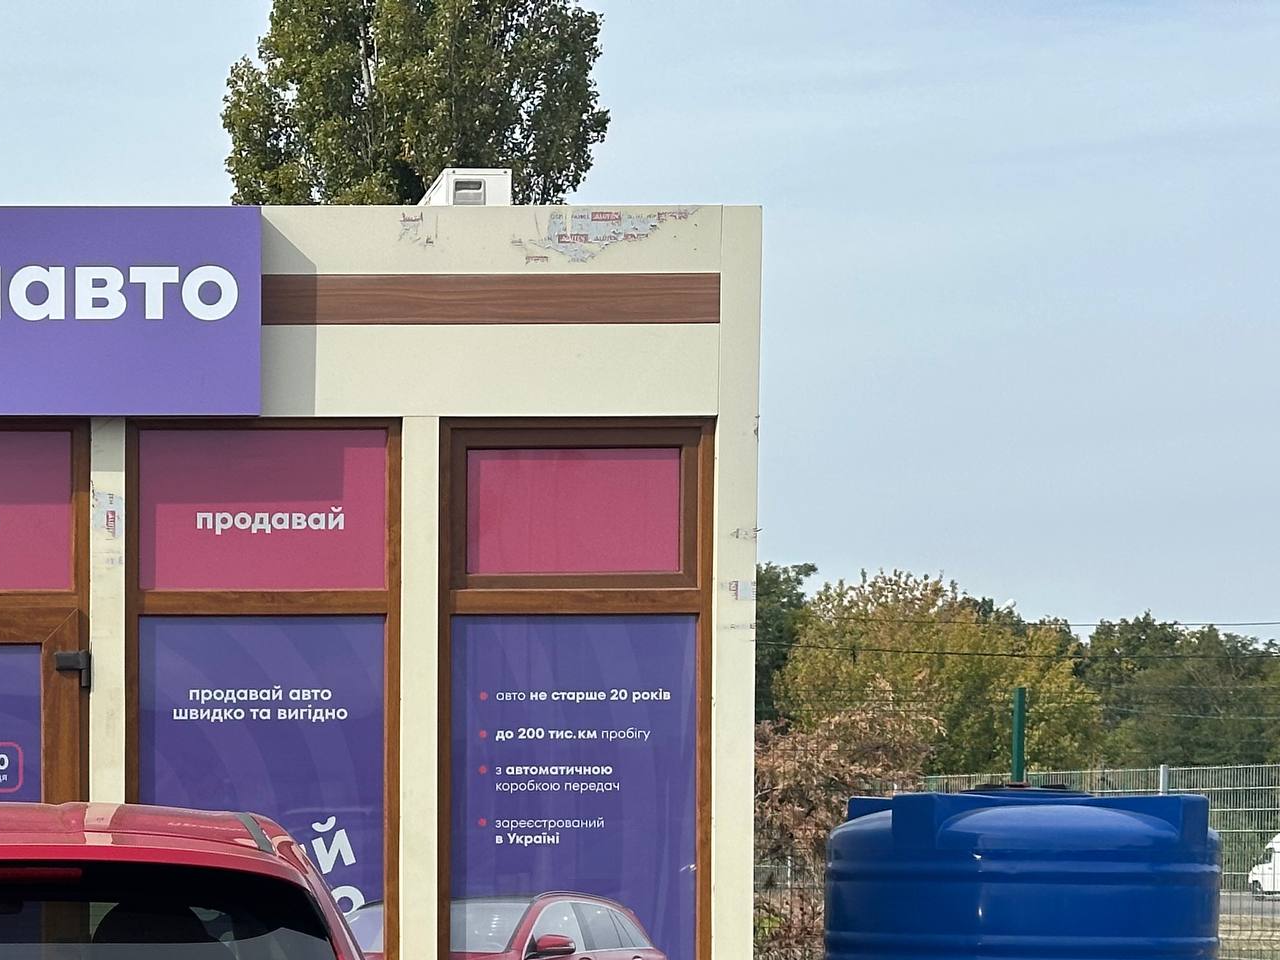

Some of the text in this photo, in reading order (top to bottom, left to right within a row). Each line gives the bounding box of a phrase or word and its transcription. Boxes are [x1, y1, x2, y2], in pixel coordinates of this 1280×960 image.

[195, 507, 345, 535] продавай
[189, 685, 332, 704] продавай авто
[496, 688, 671, 703] авто не старше 20 років
[173, 704, 348, 722] швидко та вигідно
[496, 729, 514, 741] до
[517, 728, 545, 739] 200
[601, 727, 651, 742] пробігу
[496, 765, 613, 775] з автоматичною
[496, 779, 620, 793] коробкою передач
[495, 816, 605, 830] зареєстрований
[496, 832, 560, 847] в Україні
